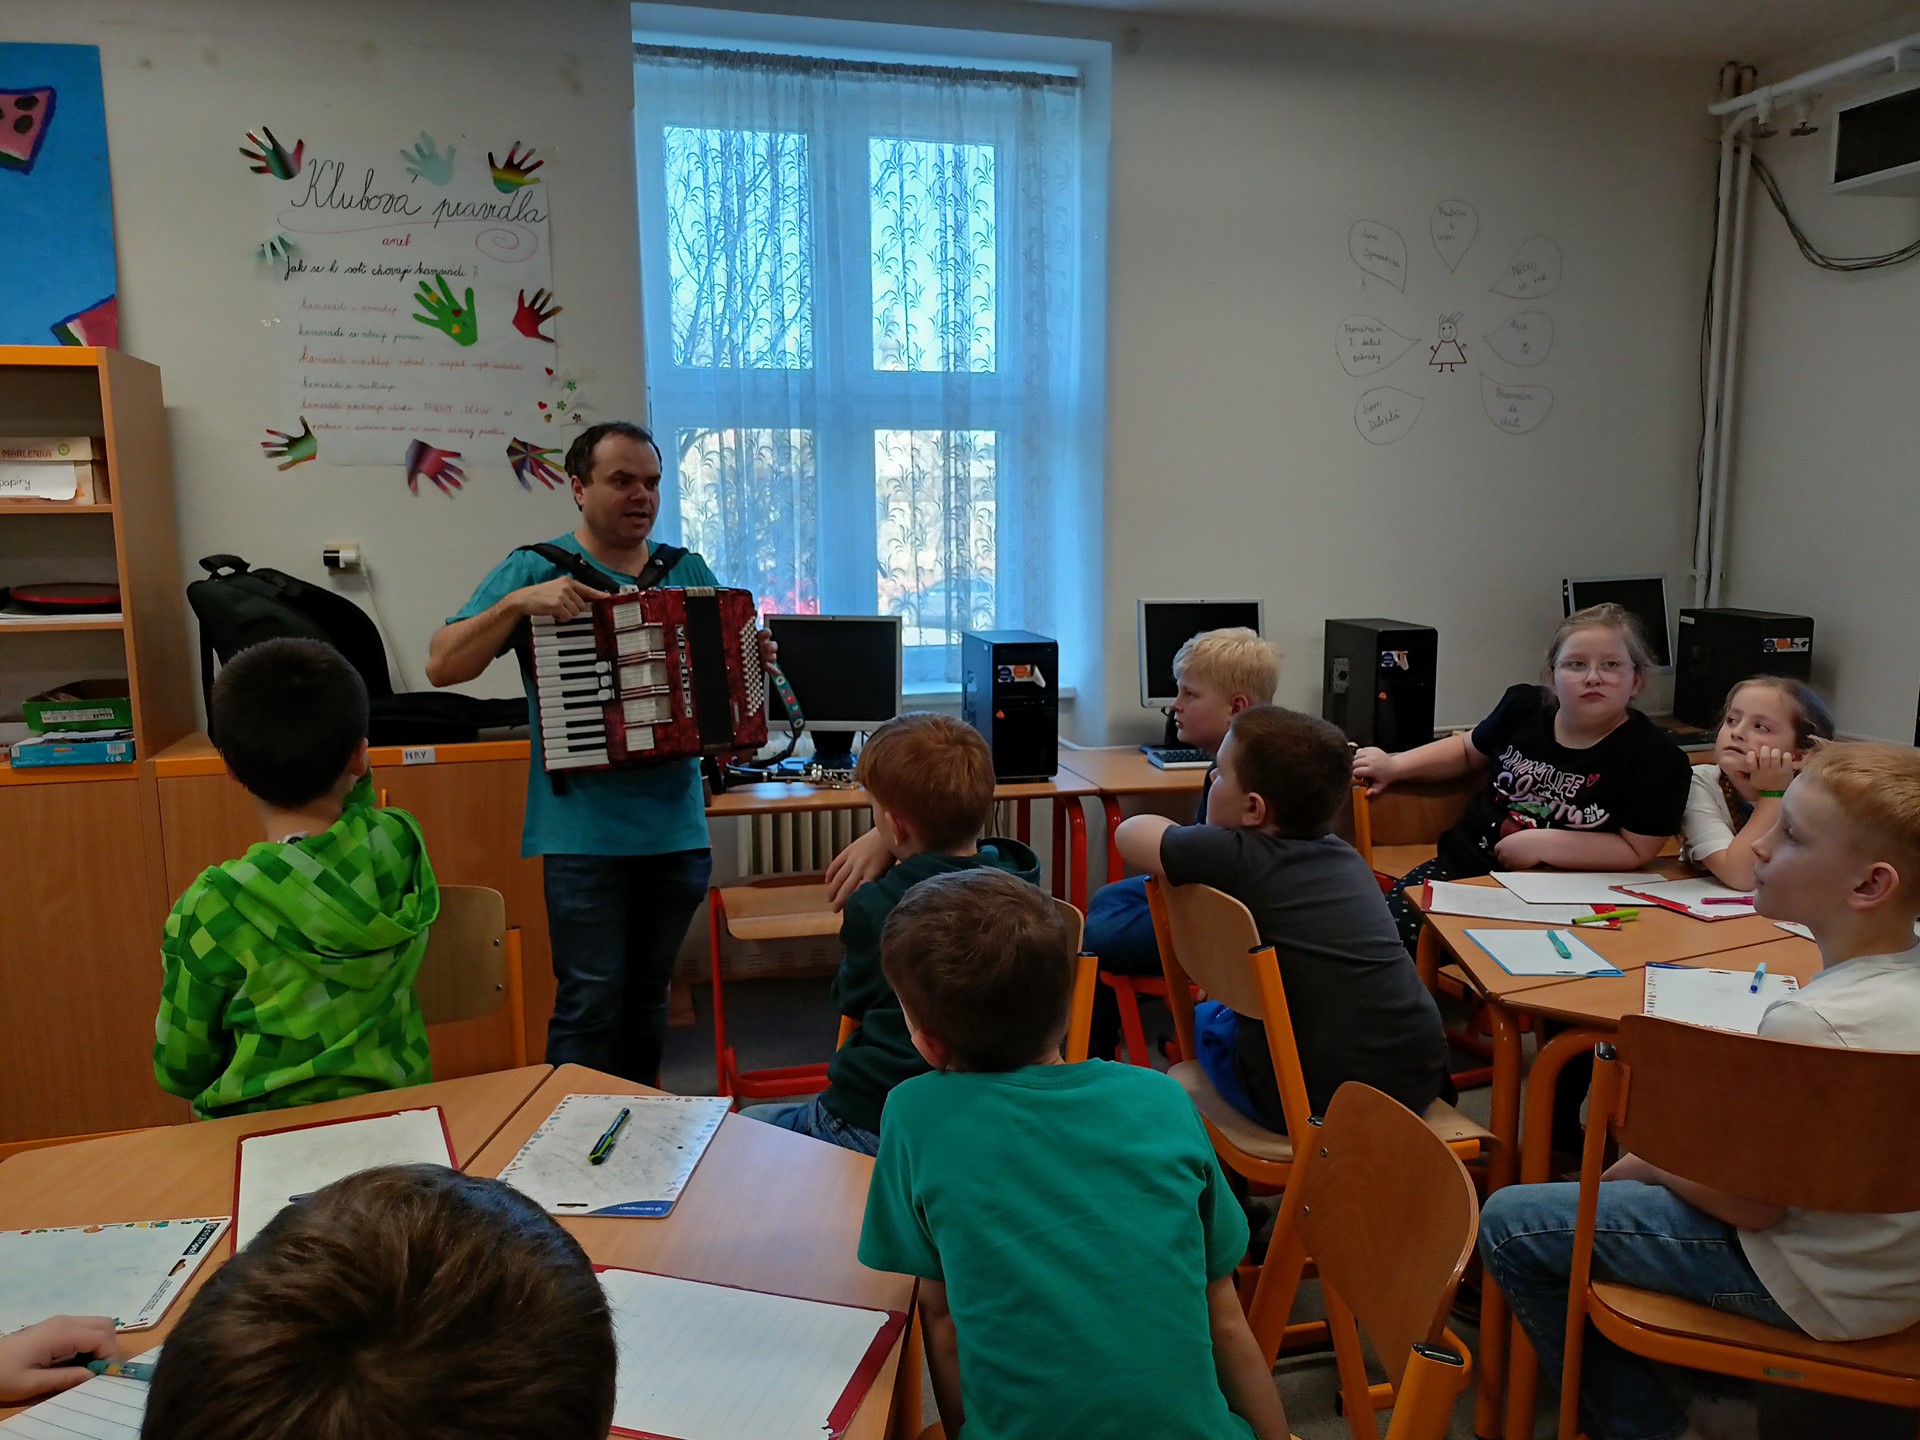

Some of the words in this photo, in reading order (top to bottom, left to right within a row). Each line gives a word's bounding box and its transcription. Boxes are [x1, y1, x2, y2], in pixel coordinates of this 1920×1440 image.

[284, 256, 308, 281] Jak
[2, 449, 52, 458] MARLENKA
[676, 625, 693, 718] DELICIA
